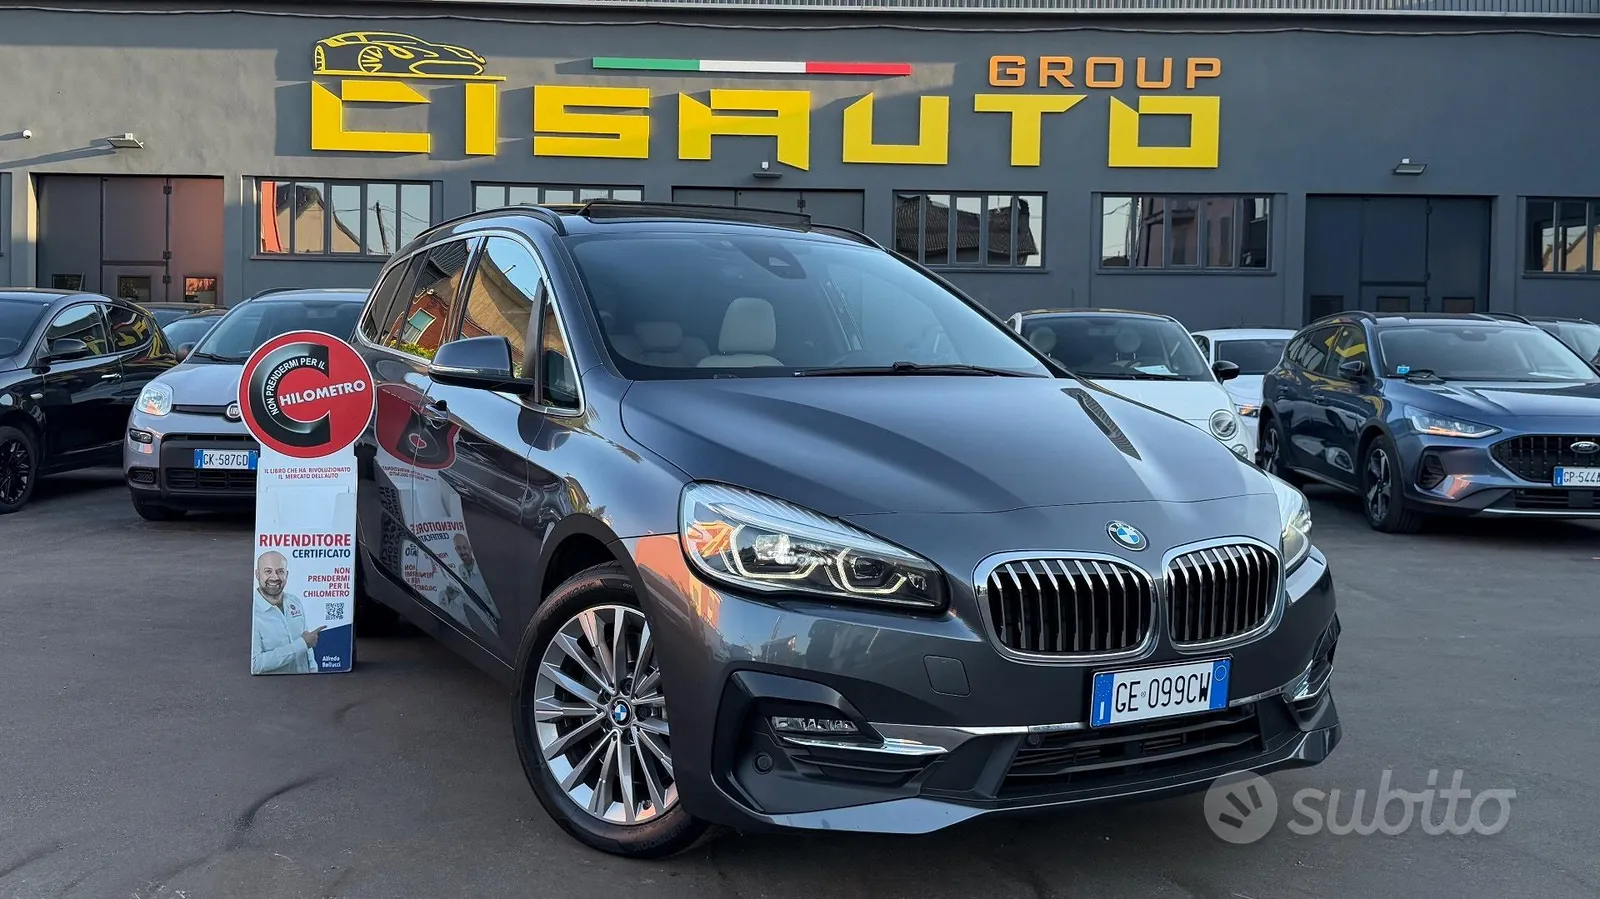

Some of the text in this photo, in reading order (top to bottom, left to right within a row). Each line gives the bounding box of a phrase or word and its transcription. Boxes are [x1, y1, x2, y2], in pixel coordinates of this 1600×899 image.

[988, 55, 1222, 89] GROUP
[311, 79, 1221, 170] CISAUTO
[266, 358, 326, 416] NON PRENDERMI PER IL
[279, 379, 366, 407] HILOMETRO
[259, 533, 351, 547] RIVENDITORE
[292, 548, 351, 558] CERTIFICATO
[334, 566, 351, 575] NON
[307, 575, 350, 583] PRENDERMI
[328, 582, 341, 590] PER
[303, 590, 350, 598] CHILOMETRO
[1115, 680, 1141, 714] GE
[1147, 671, 1212, 709] 099CW
